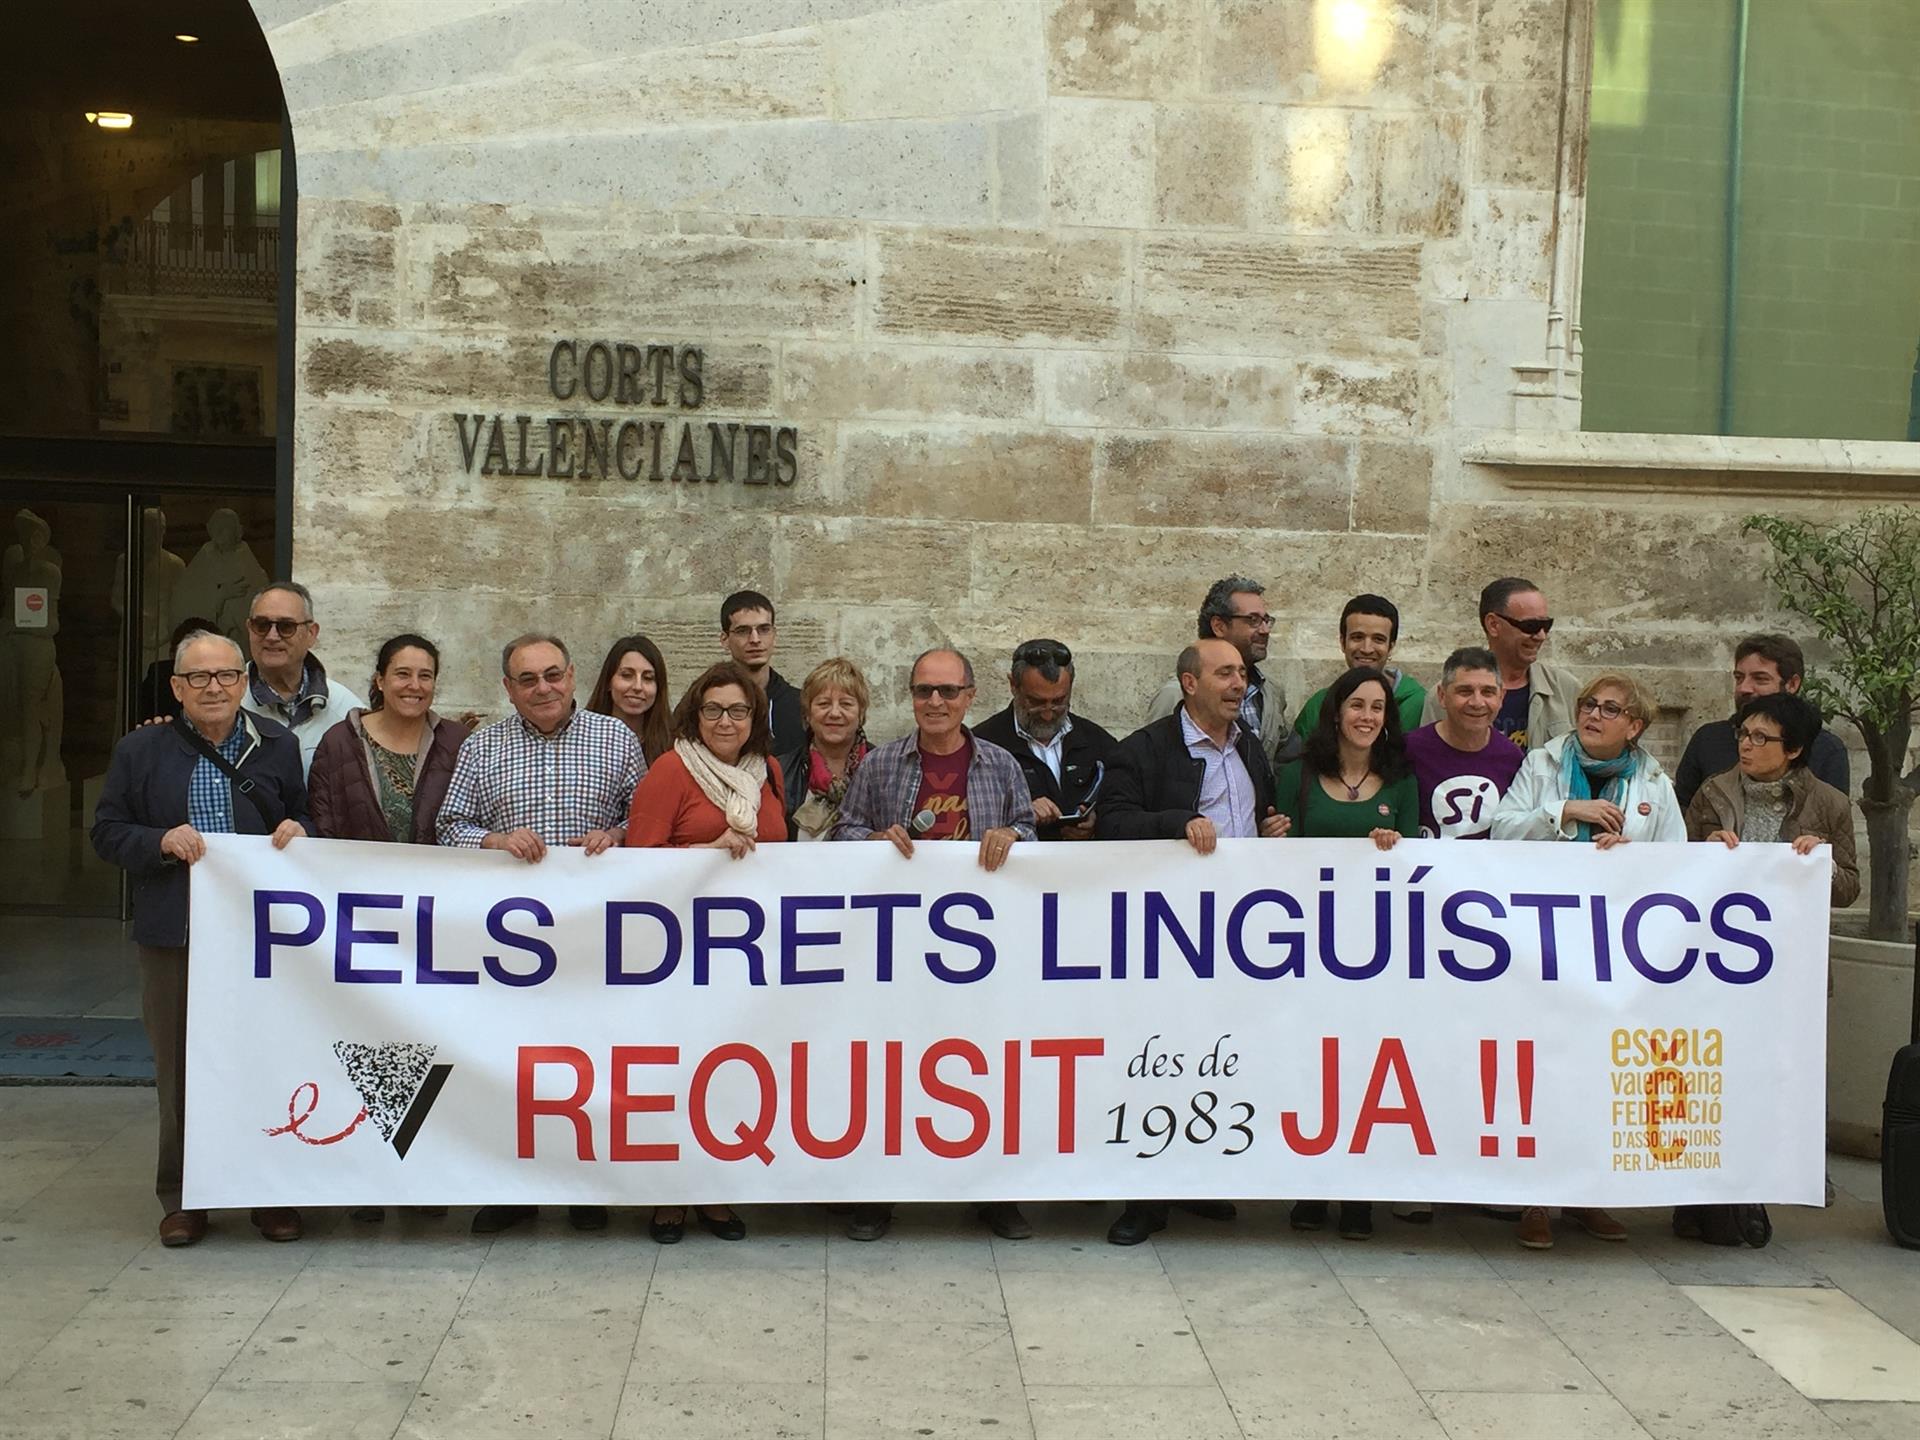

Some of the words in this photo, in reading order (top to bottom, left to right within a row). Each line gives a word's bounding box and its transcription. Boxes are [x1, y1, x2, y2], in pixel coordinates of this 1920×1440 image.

[550, 339, 704, 408] CORTS
[454, 413, 798, 487] VALENCIANES
[254, 889, 557, 987] PELS
[606, 893, 996, 986] DRETS
[1042, 866, 1773, 985] LINGÜÍSTICS
[1127, 1034, 1185, 1078] des
[1198, 1033, 1239, 1078] de
[1611, 1028, 1723, 1068] escola
[516, 1038, 1105, 1165] REQUISIT
[1280, 1036, 1436, 1156] JA
[1479, 1039, 1537, 1158] !!
[1611, 1071, 1723, 1096] valenciana
[1105, 1091, 1255, 1159] 1983
[1612, 1096, 1723, 1126] FEDERACIÓ
[1612, 1129, 1722, 1149] D'ASSOCIACIONS
[1613, 1153, 1642, 1172] PER
[1645, 1153, 1661, 1171] LA
[1664, 1151, 1722, 1170] LLENGUA
